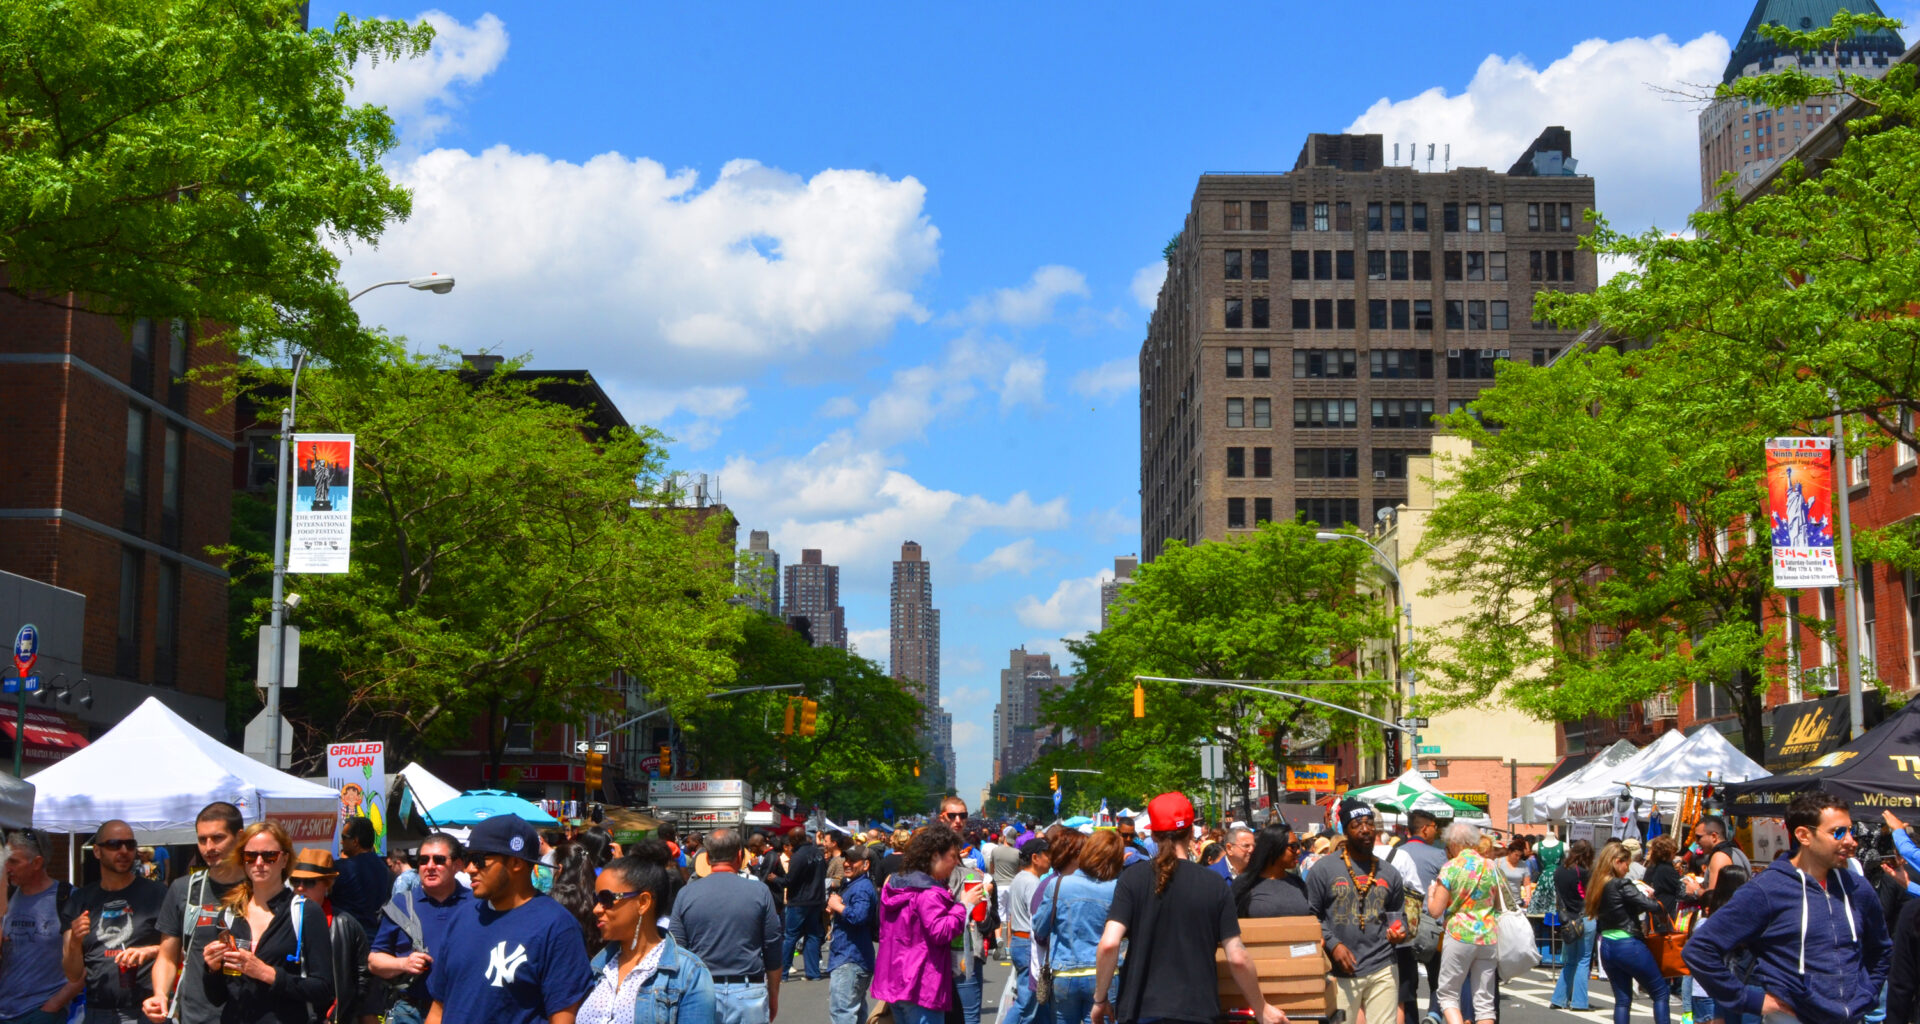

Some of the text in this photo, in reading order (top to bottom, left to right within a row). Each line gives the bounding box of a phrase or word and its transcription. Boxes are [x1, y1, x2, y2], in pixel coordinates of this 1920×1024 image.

[330, 744, 382, 757] GRILLED
[1387, 731, 1395, 774] TURCO
[338, 756, 374, 768] CORN
[680, 782, 707, 792] CALAMARI
[1465, 793, 1488, 802] STORE
[1568, 800, 1588, 817] HENNA
[485, 941, 528, 987] NY
